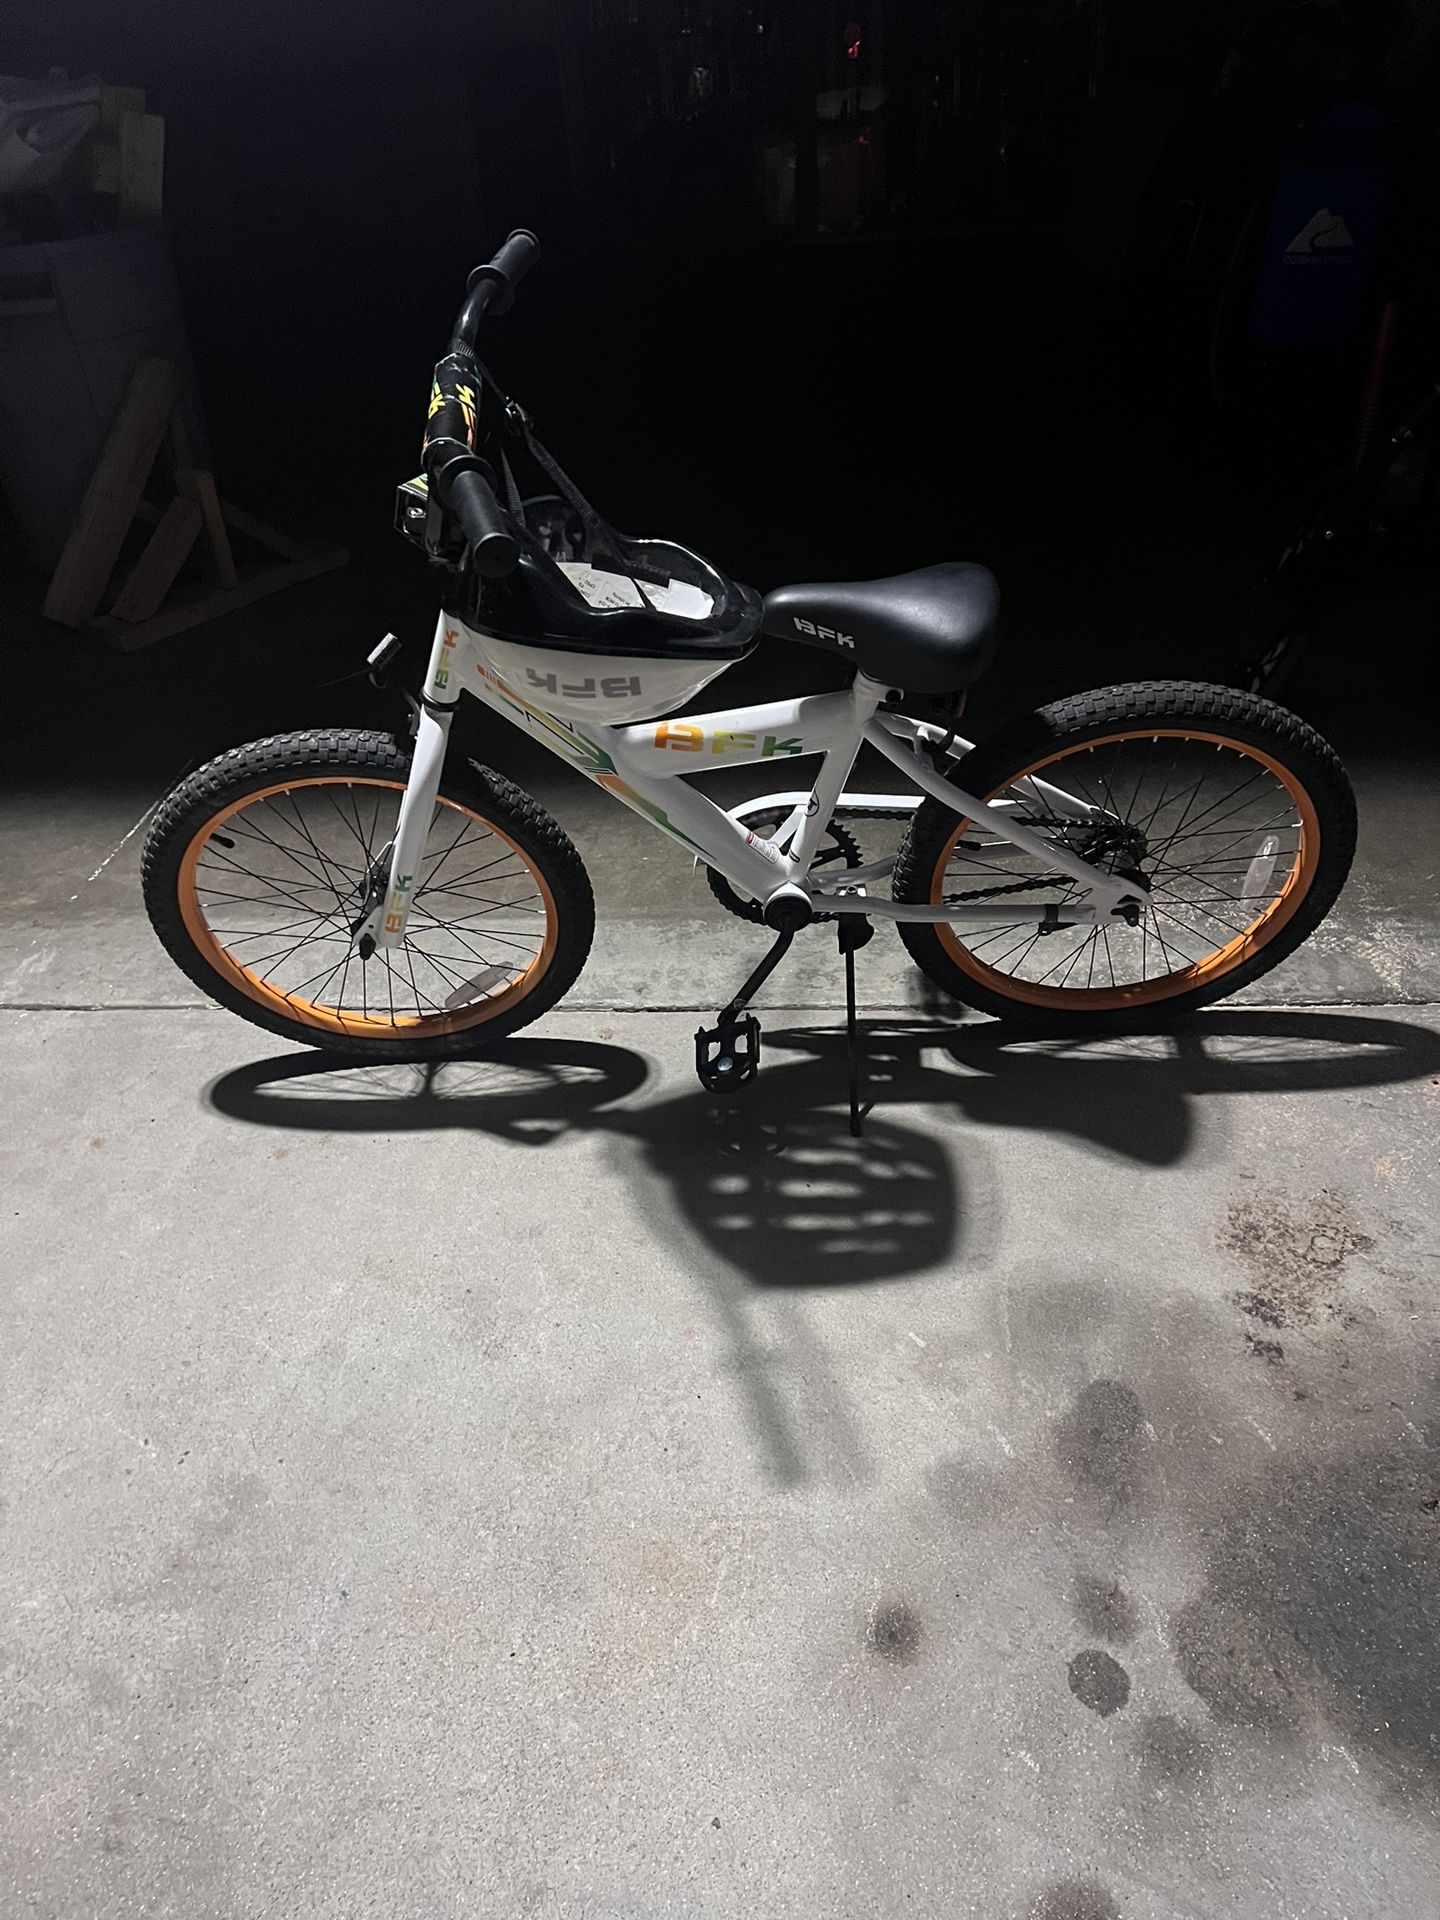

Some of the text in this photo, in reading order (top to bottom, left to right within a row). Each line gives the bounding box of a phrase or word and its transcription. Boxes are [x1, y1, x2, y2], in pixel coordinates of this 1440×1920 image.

[792, 616, 855, 649] BFK
[434, 630, 459, 690] BFK
[526, 667, 642, 699] BFK
[654, 720, 804, 757] BFK
[384, 873, 413, 933] BFK
